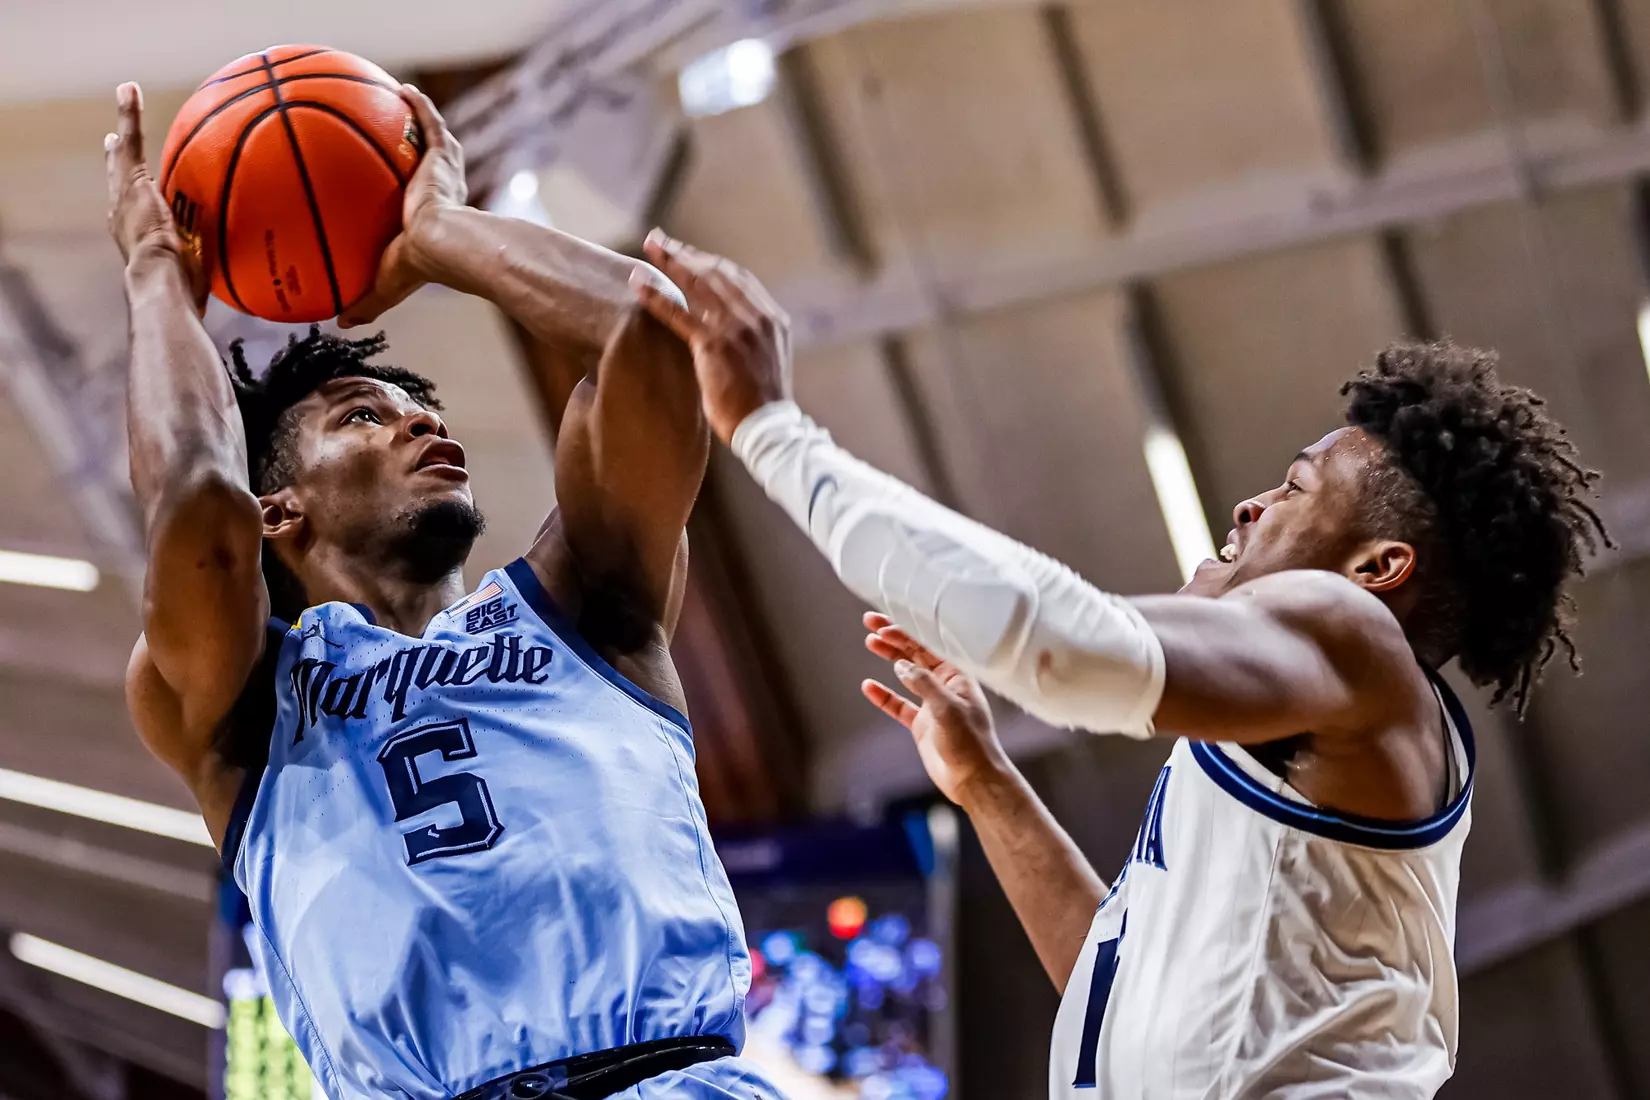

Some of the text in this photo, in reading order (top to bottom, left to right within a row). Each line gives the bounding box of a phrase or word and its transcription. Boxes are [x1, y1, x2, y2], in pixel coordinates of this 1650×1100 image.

[466, 597, 503, 623] BIG
[466, 603, 518, 633] EAST
[290, 633, 553, 746] Marquette
[376, 717, 505, 867] 5
